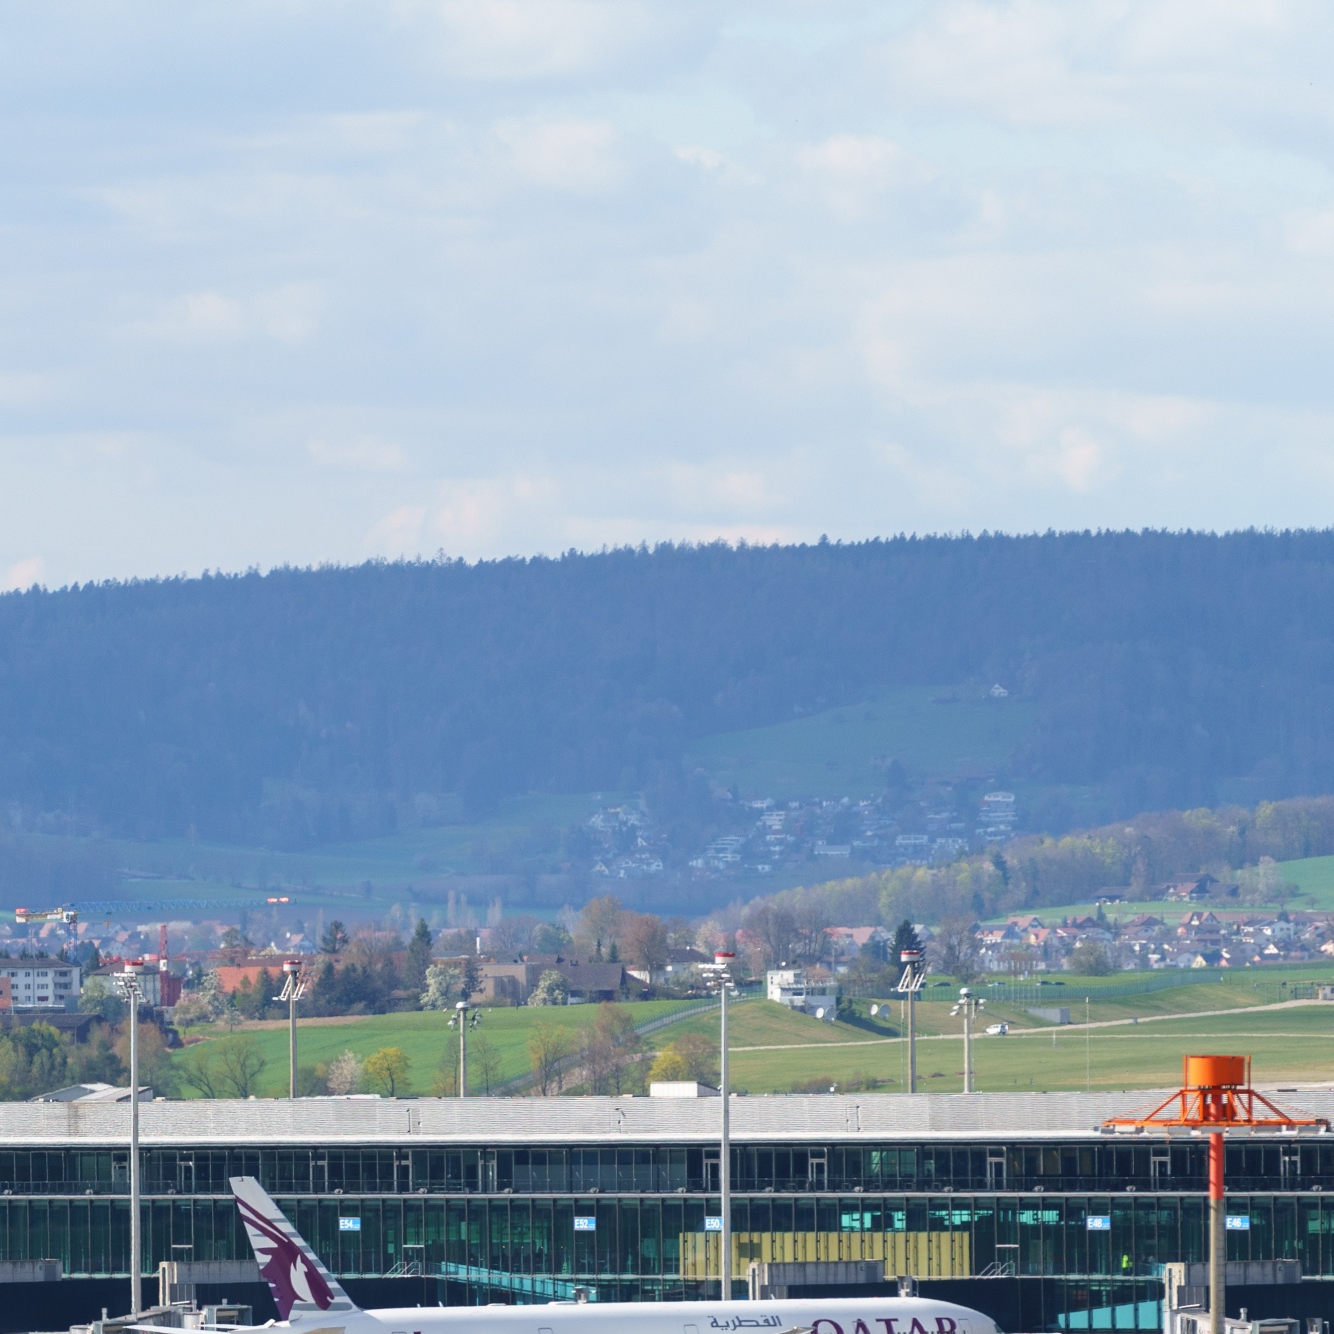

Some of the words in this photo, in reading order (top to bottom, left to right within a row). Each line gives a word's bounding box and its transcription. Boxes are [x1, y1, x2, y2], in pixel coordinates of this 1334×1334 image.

[339, 1219, 354, 1229] E54
[574, 1218, 588, 1229] E52
[705, 1218, 720, 1229] E50
[707, 1314, 782, 1331] القطرية
